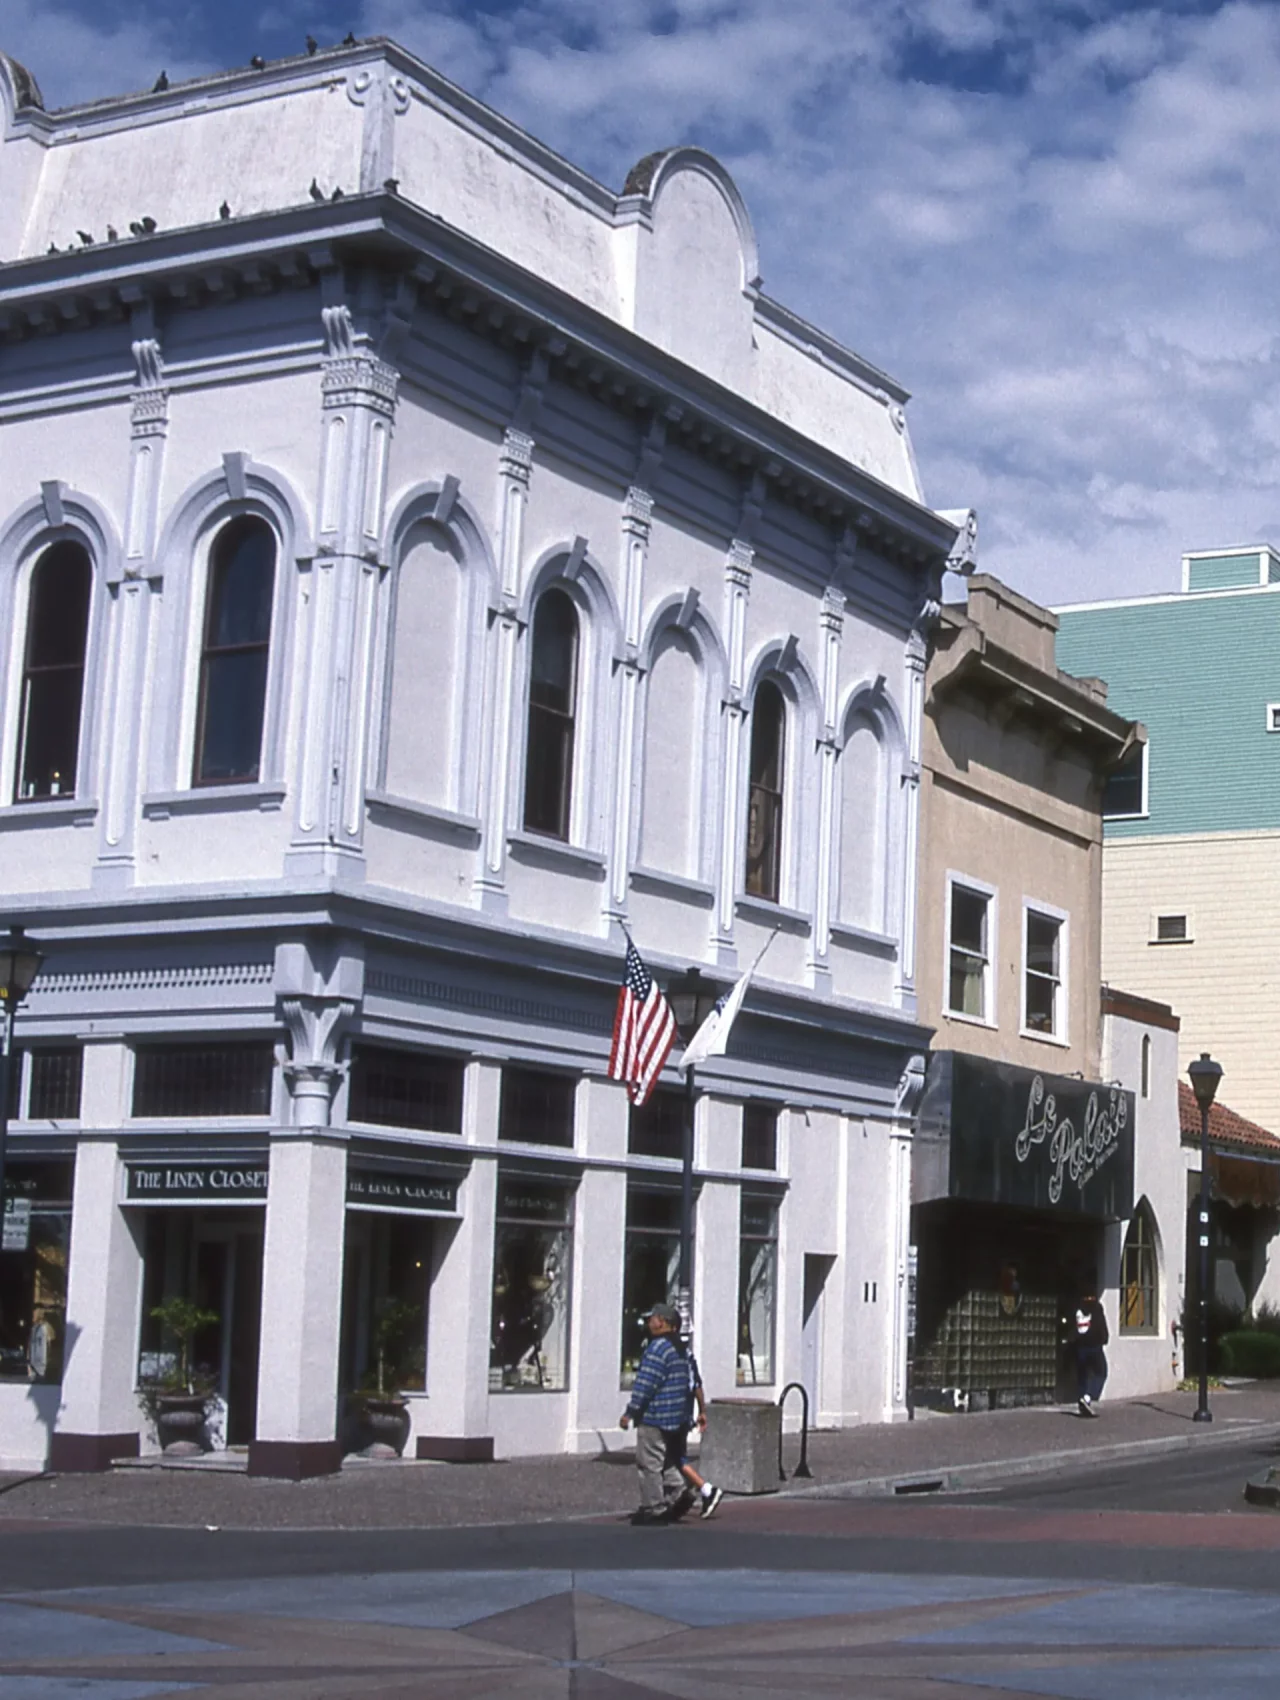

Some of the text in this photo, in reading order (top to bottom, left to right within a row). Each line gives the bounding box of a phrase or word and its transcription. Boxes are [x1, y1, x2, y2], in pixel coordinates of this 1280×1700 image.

[1016, 1074, 1057, 1162] Le
[1049, 1089, 1128, 1204] Palais
[135, 1169, 269, 1189] THE LINEN CLOSET
